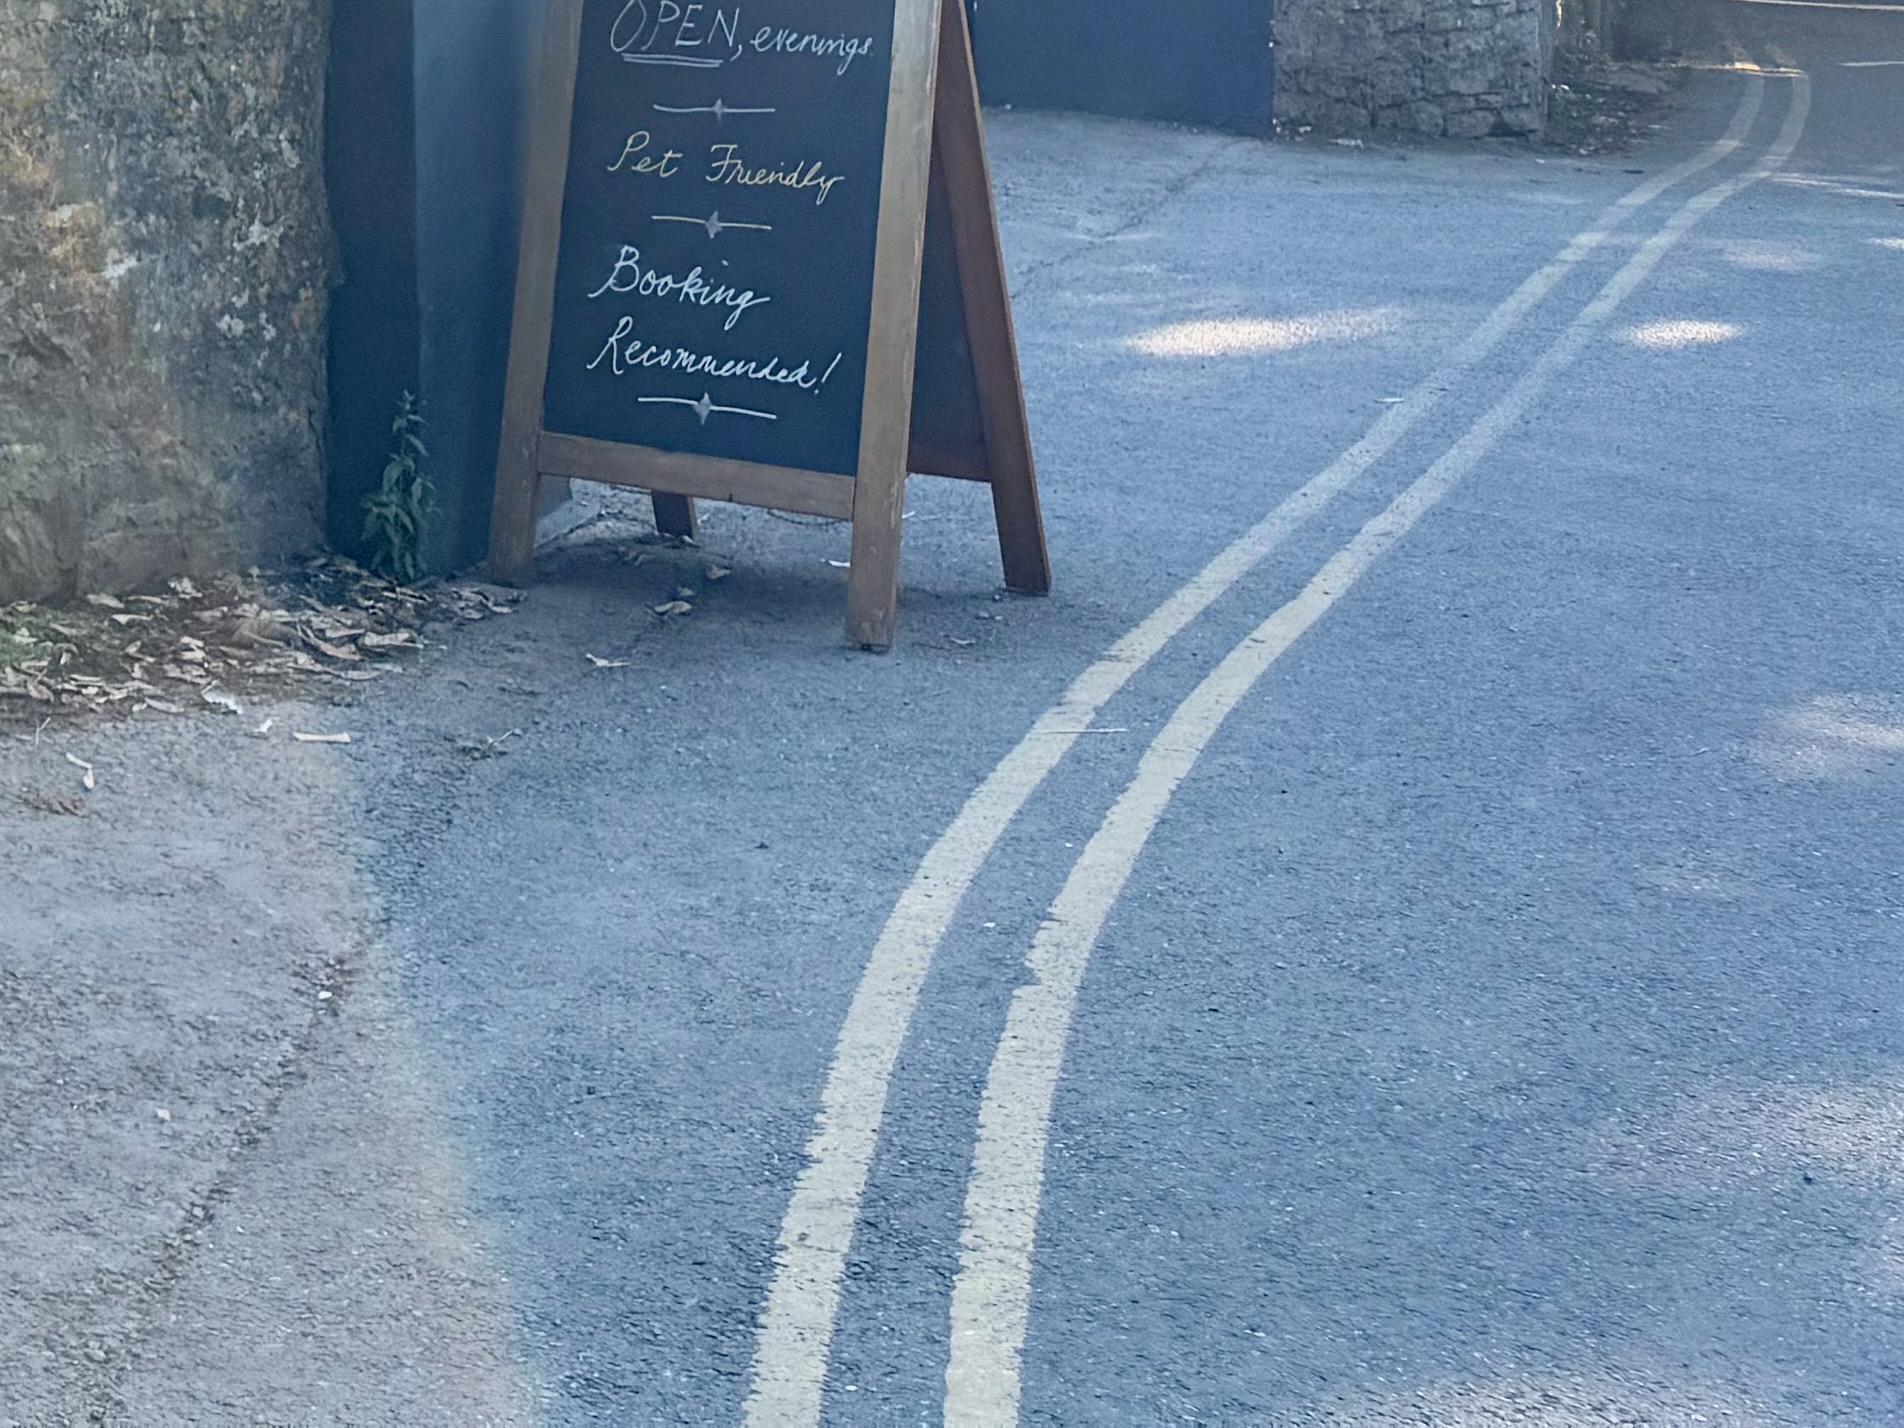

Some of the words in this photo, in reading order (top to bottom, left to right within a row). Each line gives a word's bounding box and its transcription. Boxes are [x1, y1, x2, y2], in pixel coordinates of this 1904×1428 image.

[607, 130, 683, 178] Pet
[705, 144, 845, 206] Friendly
[587, 244, 771, 331] Booking
[586, 316, 842, 395] Recommended!
